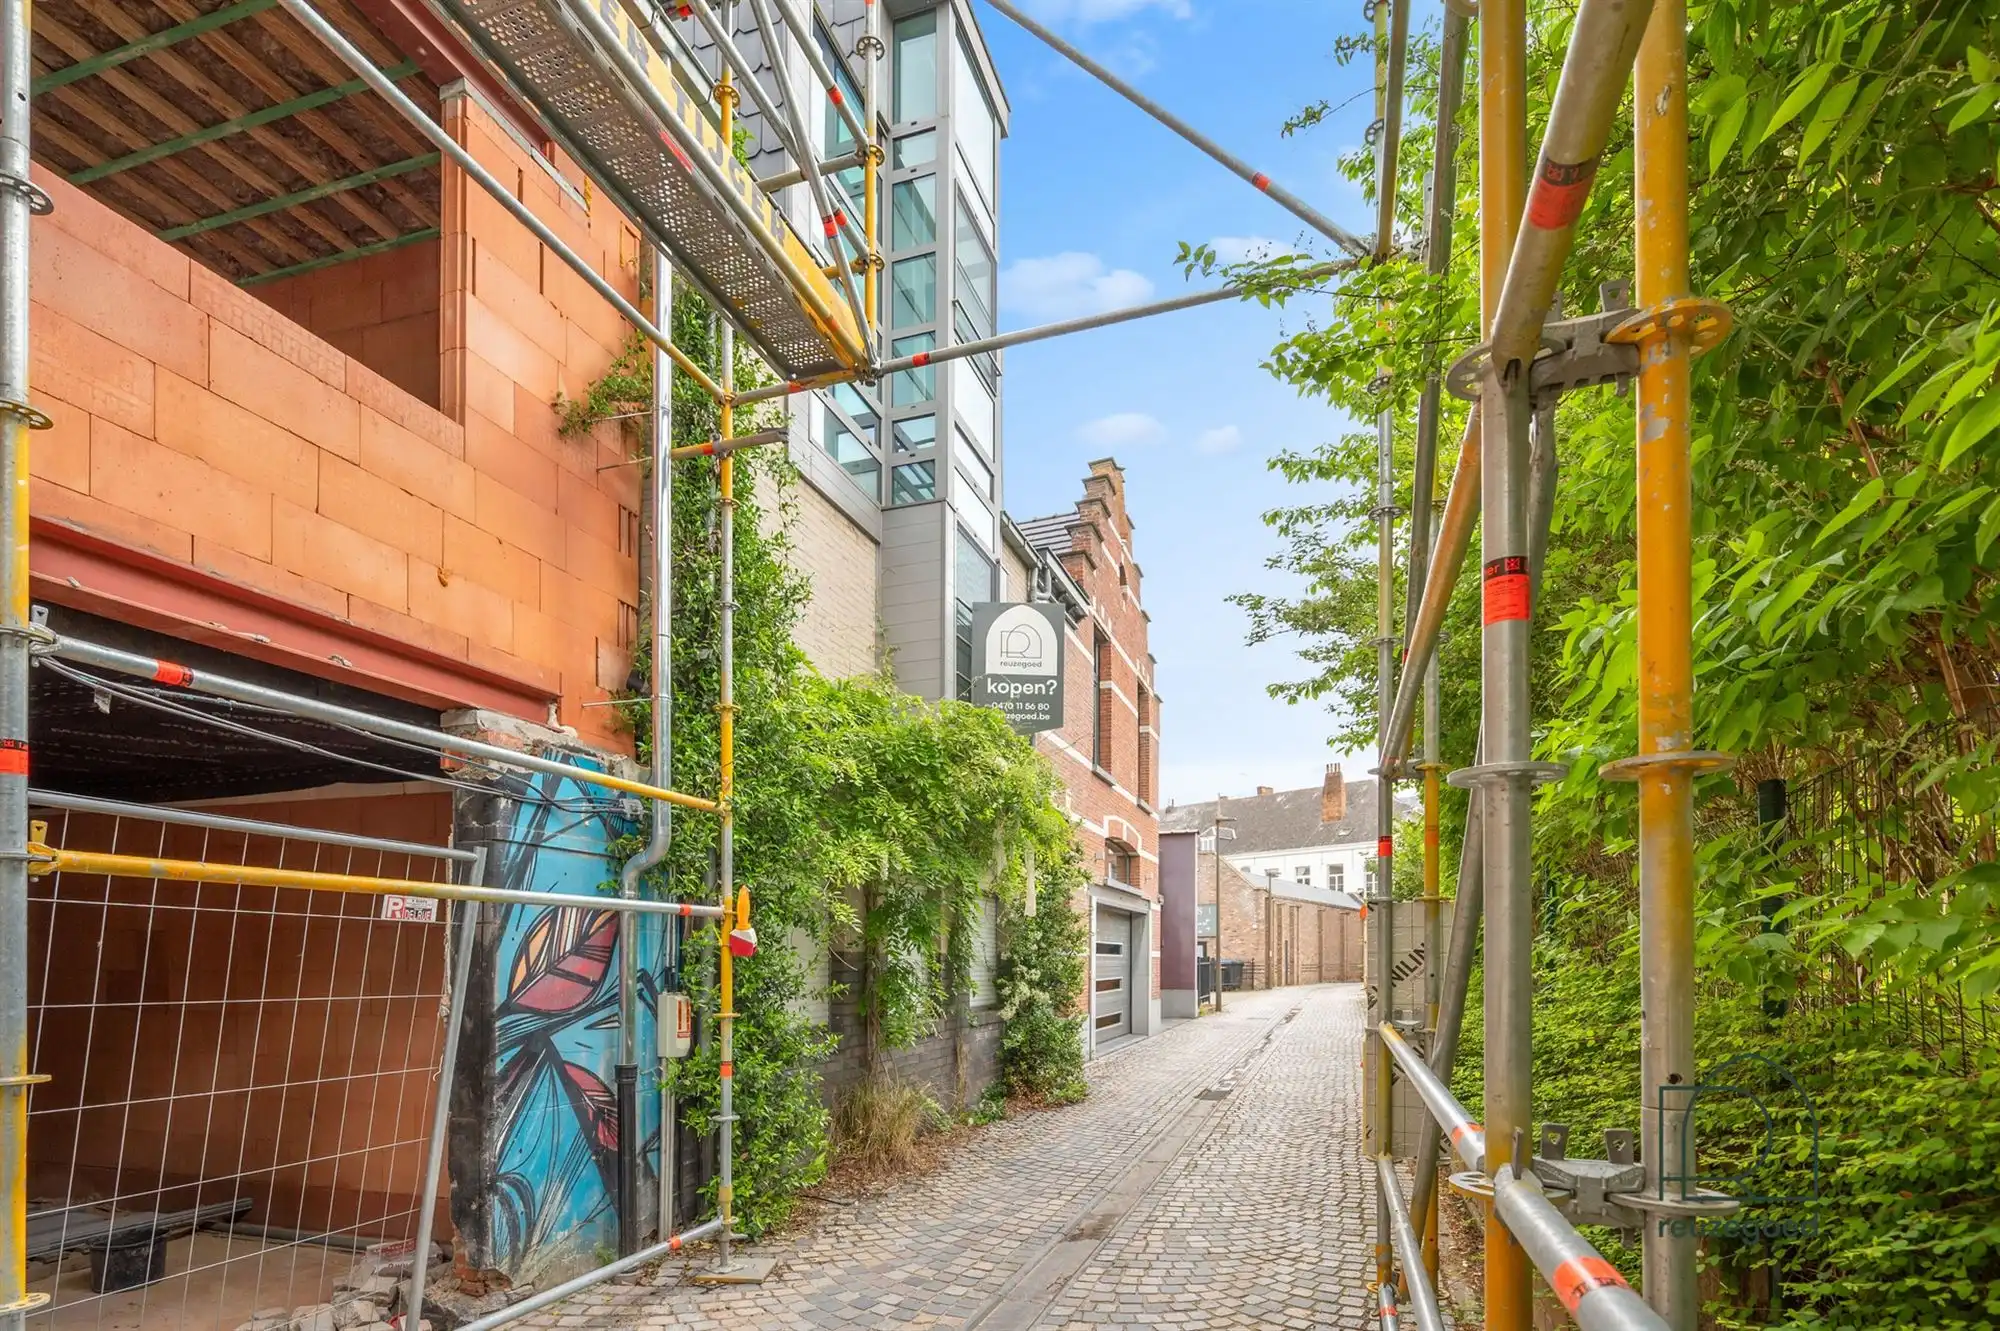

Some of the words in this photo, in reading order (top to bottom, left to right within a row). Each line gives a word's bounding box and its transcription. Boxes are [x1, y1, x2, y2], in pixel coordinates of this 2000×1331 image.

[1000, 660, 1042, 669] reuzegoed
[987, 677, 1058, 698] kopen?
[1016, 702, 1023, 710] 11
[1037, 703, 1050, 711] 80
[1000, 712, 1050, 721] zegoed.be
[1386, 942, 1424, 990] NILIN
